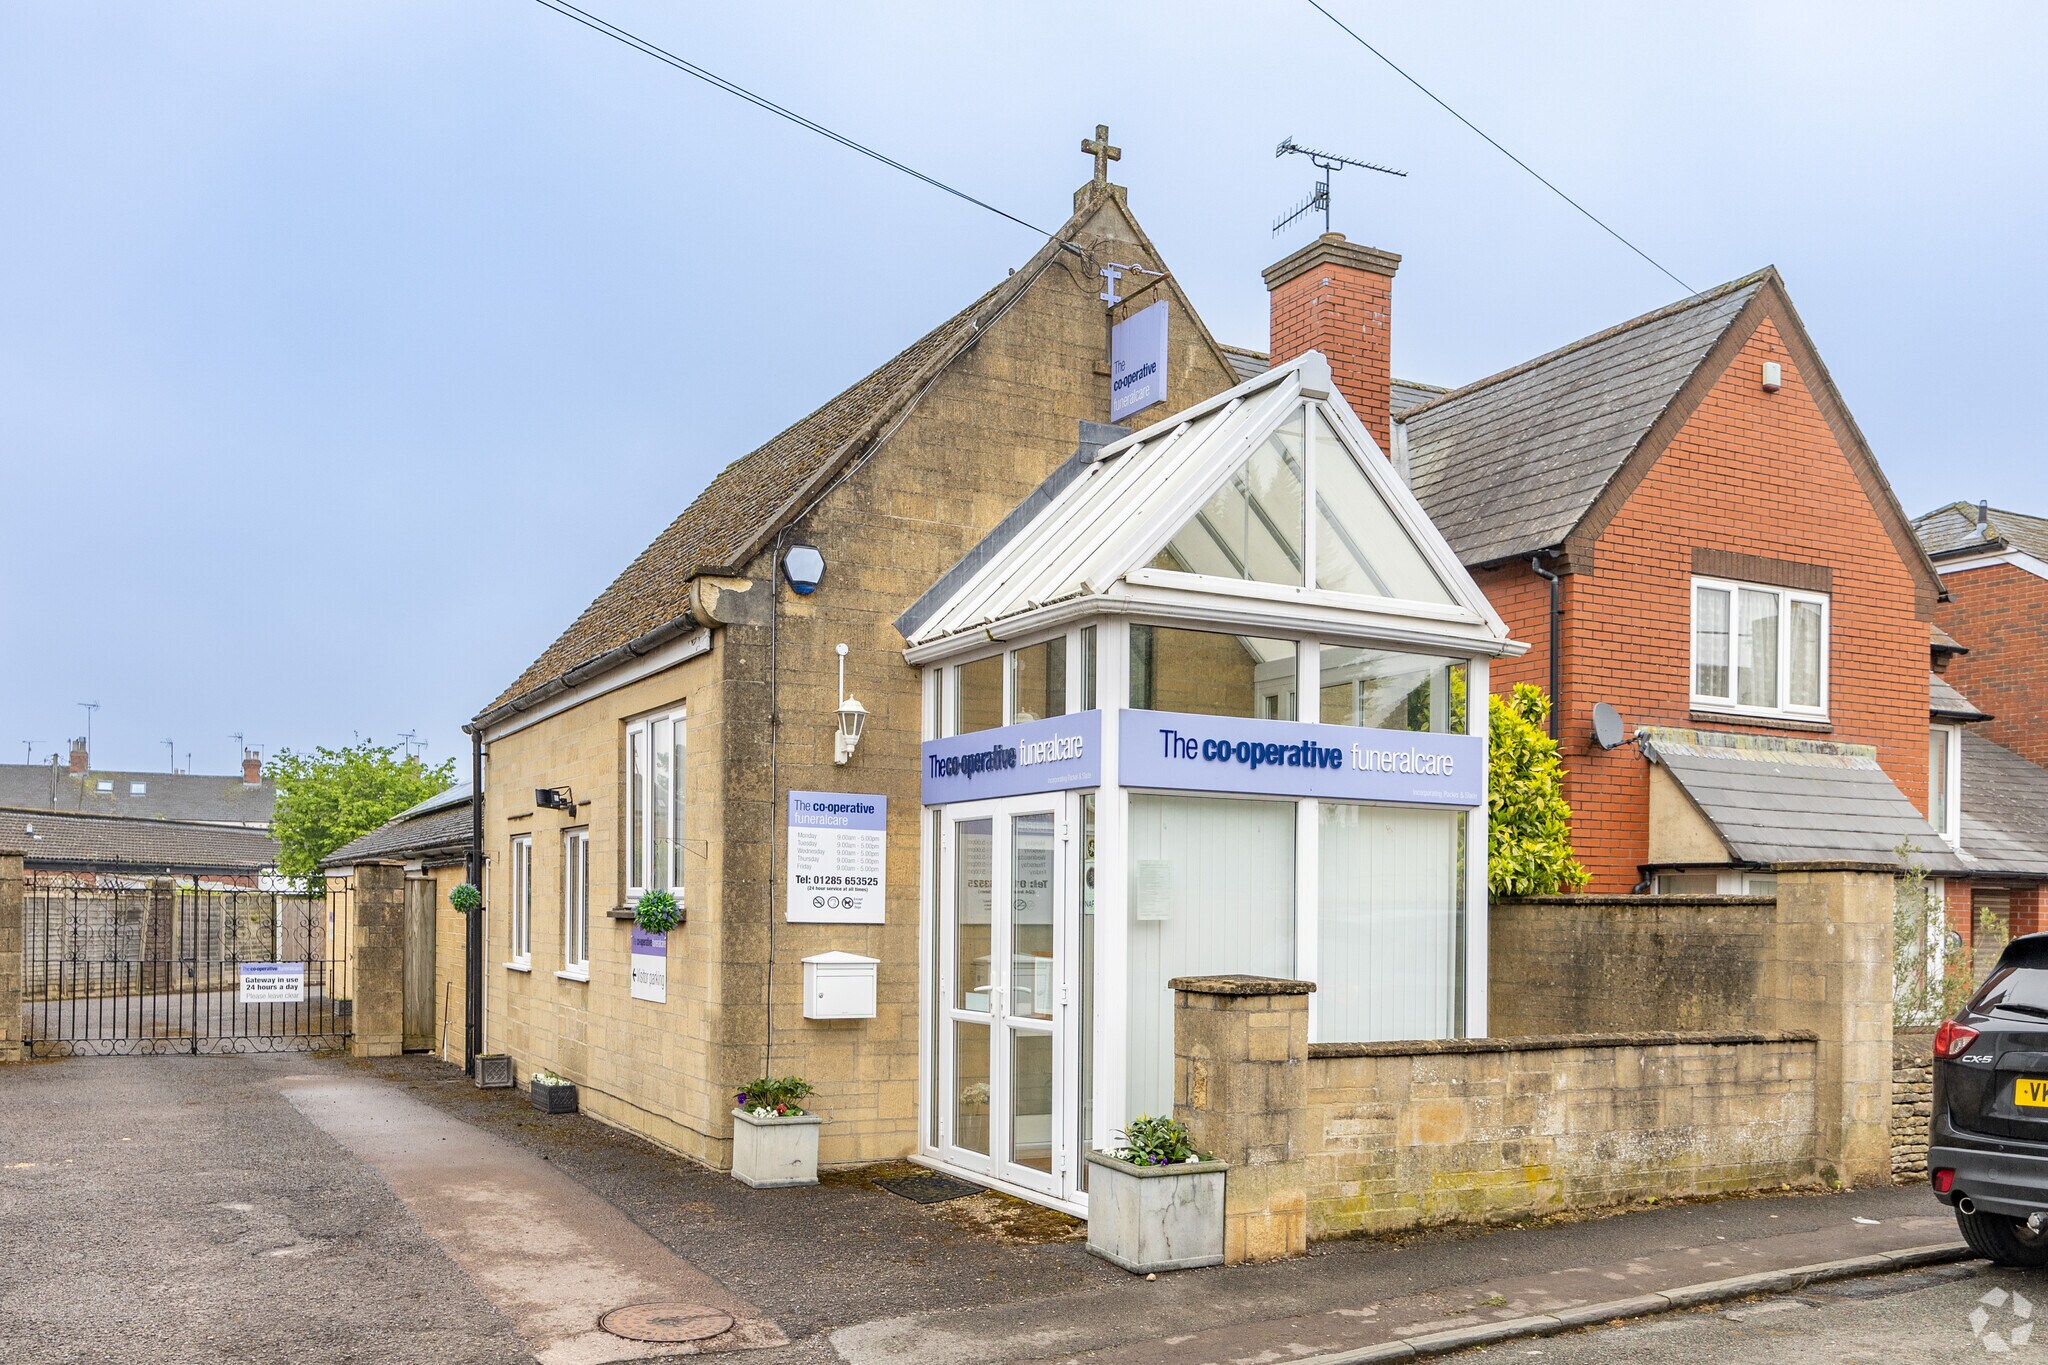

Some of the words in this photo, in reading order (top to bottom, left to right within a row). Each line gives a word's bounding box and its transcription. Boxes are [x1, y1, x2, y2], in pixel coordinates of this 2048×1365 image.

[1114, 360, 1126, 374] The
[1114, 362, 1156, 391] co-operative
[929, 754, 945, 779] The
[946, 745, 1018, 780] co-operative
[1019, 733, 1083, 766] funeralcare
[1159, 729, 1198, 759] The
[1202, 739, 1343, 770] co-operative
[1350, 743, 1454, 776] funeralcare
[795, 800, 810, 811] The
[813, 803, 874, 814] co-operative
[795, 812, 848, 825] funeralcare
[795, 875, 811, 884] Tel:
[814, 876, 842, 885] 01285
[845, 877, 878, 886] 653525
[649, 970, 664, 990] parking
[1962, 1055, 1993, 1063] CX-5
